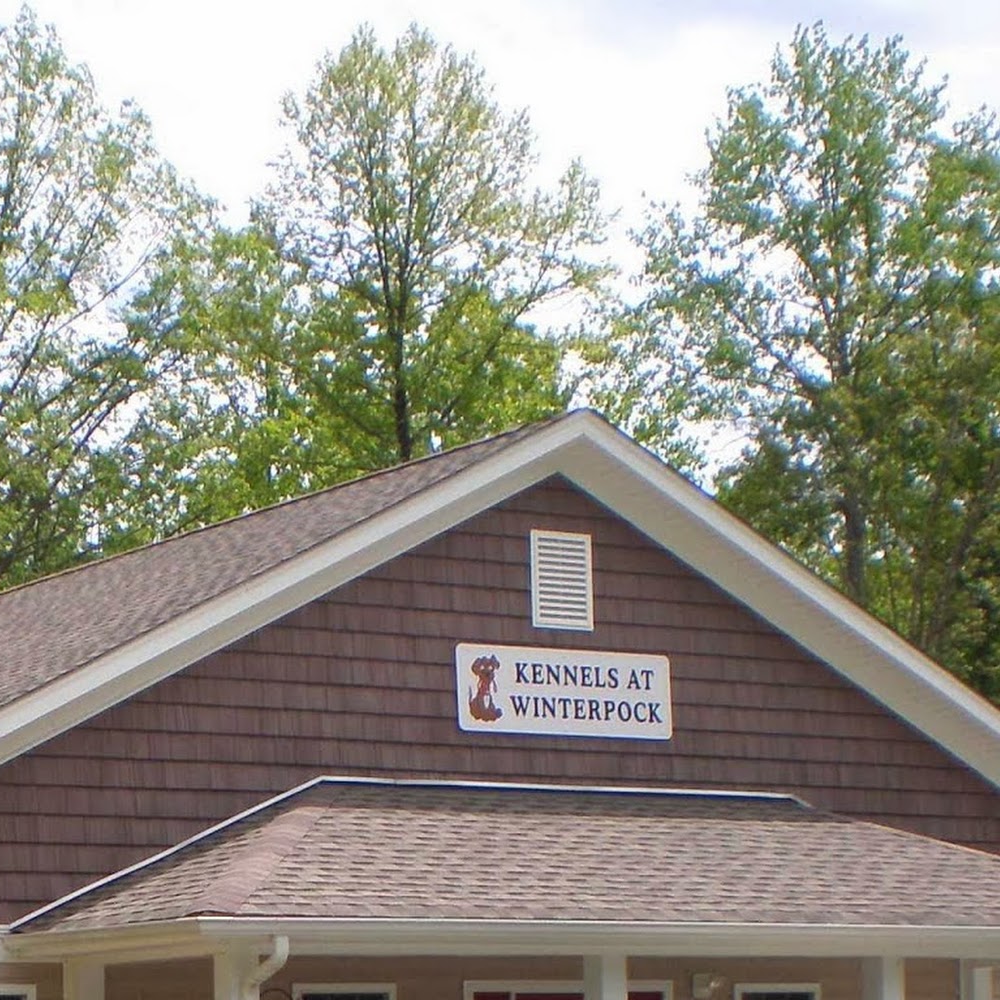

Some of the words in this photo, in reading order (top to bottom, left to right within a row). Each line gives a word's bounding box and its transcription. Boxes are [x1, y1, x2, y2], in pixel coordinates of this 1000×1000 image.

[515, 662, 619, 689] KENNELS
[627, 669, 654, 690] AT
[510, 696, 663, 724] WINTERPOCK
